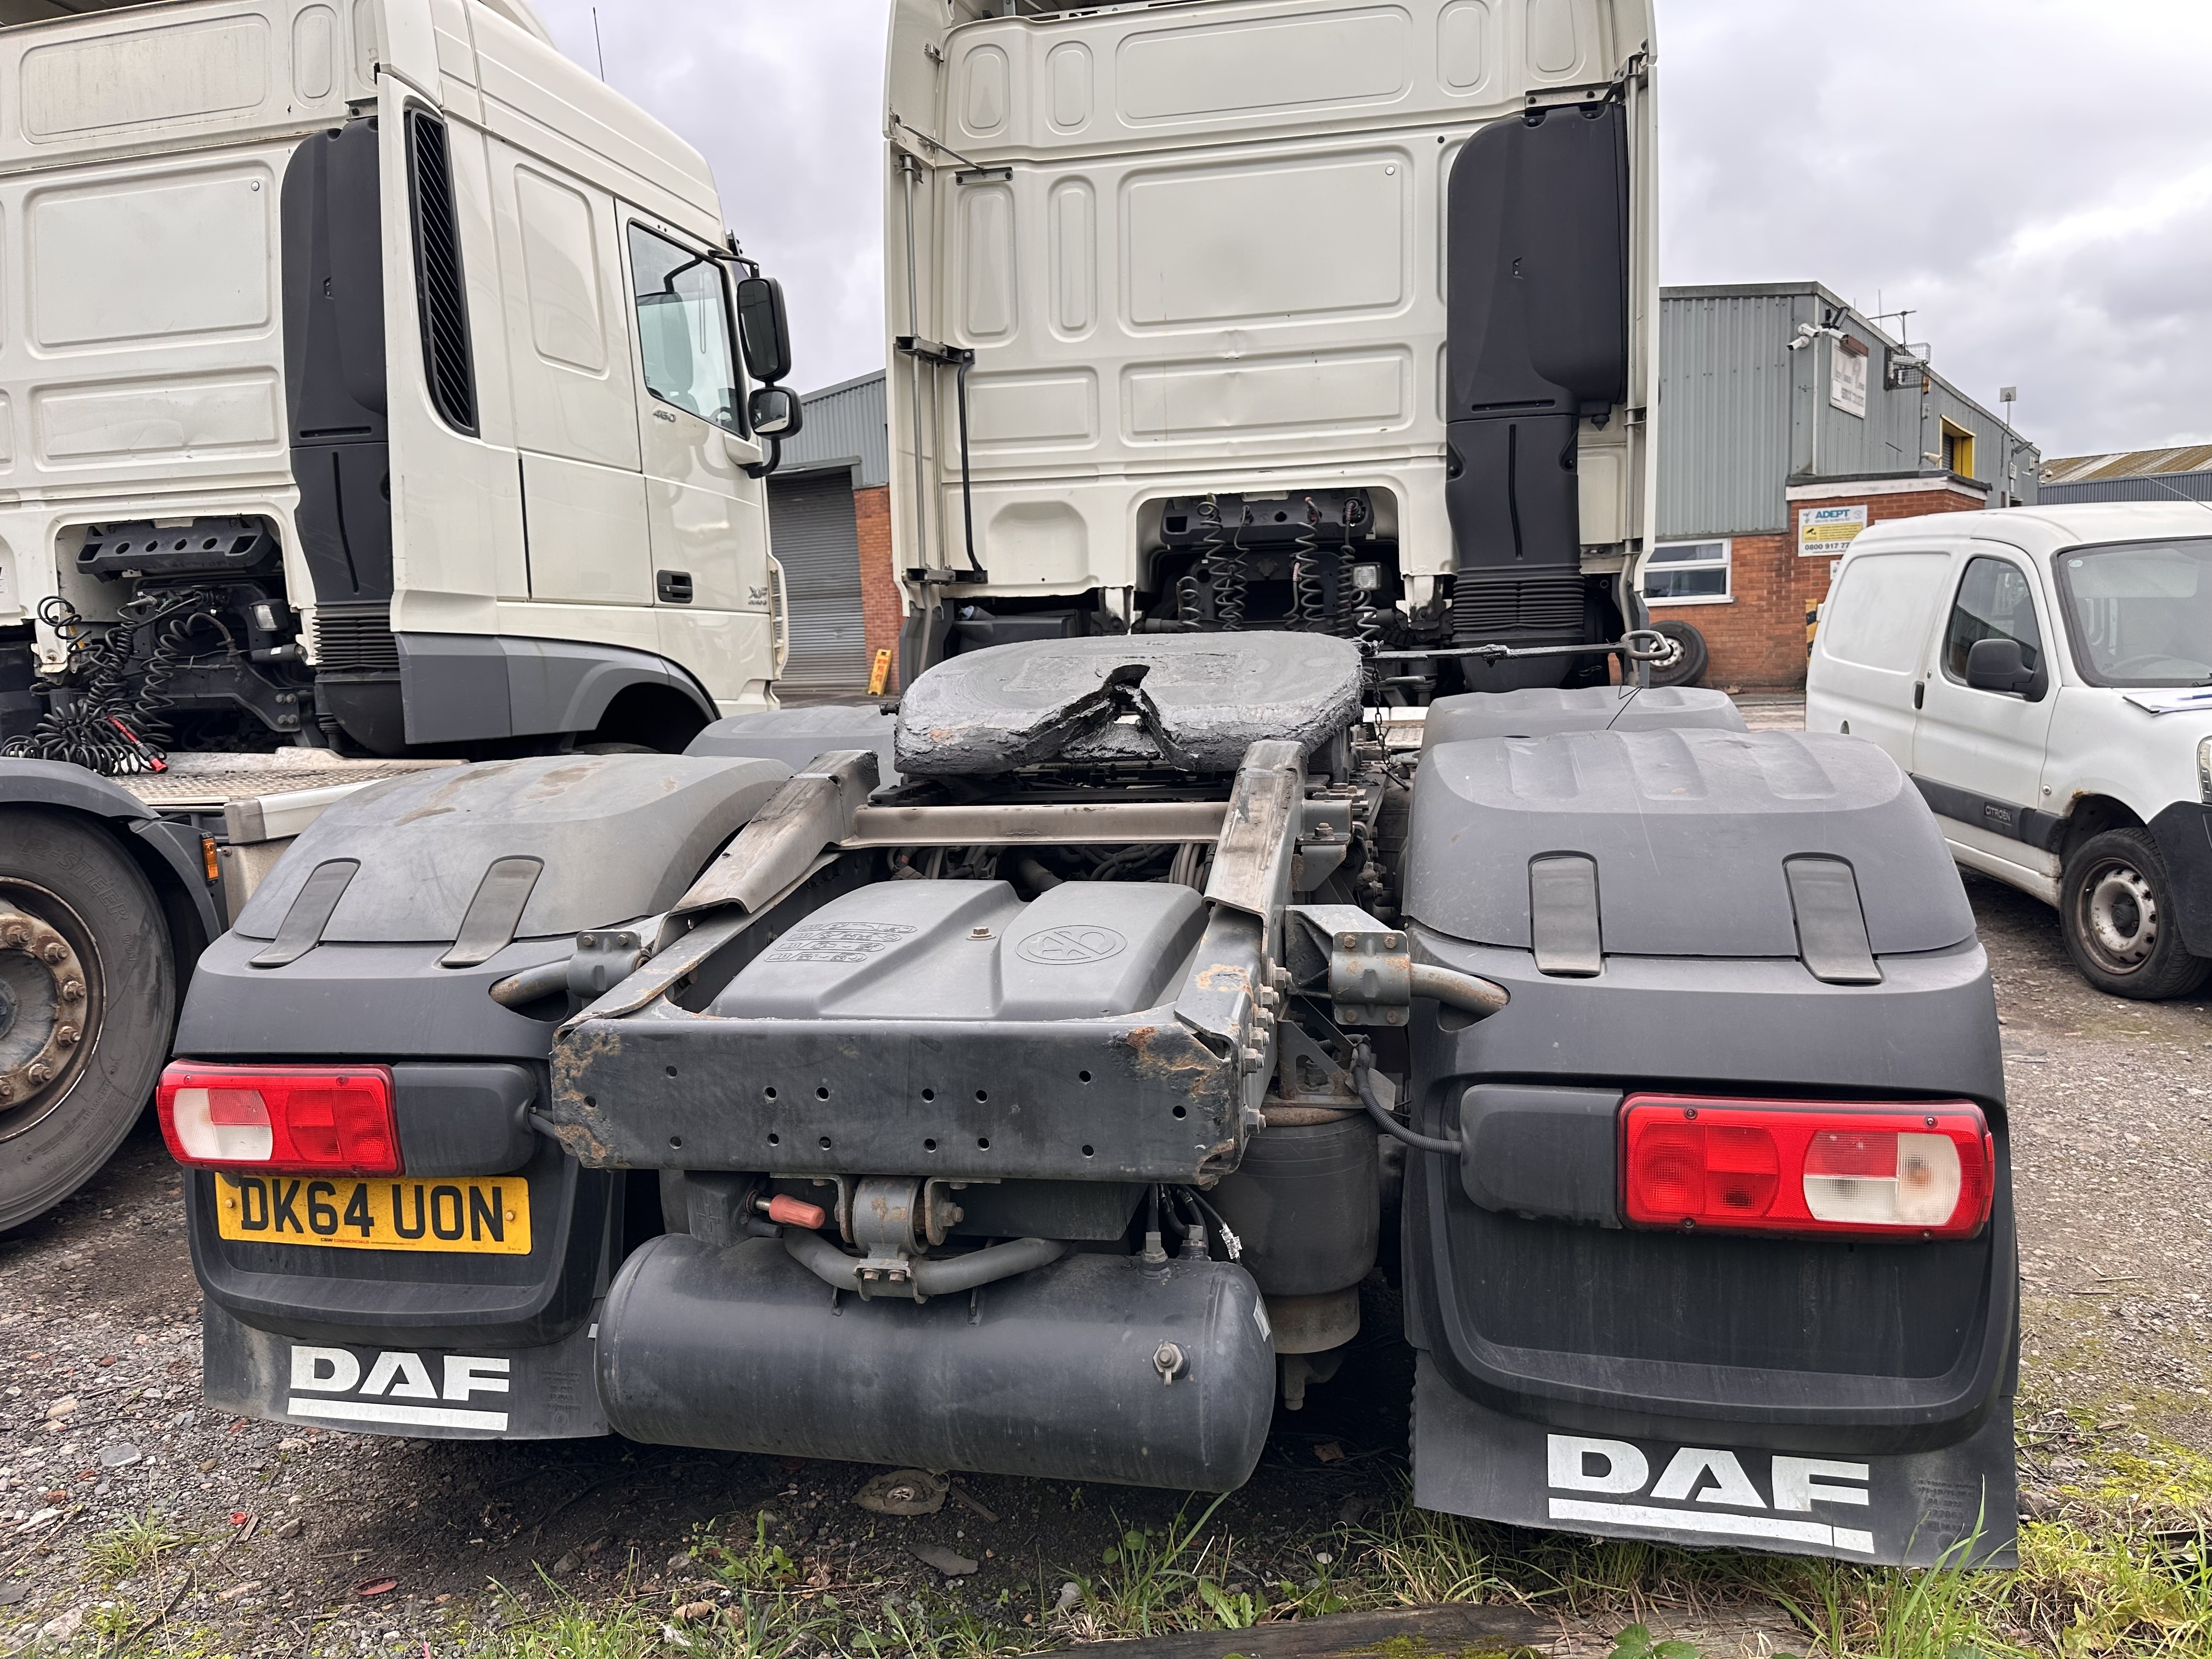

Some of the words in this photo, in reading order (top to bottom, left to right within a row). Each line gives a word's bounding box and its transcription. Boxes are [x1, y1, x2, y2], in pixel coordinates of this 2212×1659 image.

[653, 410, 676, 422] 460
[1815, 509, 1850, 519] ADEPT
[748, 586, 768, 599] XF
[19, 838, 129, 924] R-STEER
[122, 934, 137, 962] 001
[240, 1178, 374, 1237] DK64
[392, 1184, 504, 1242] UON
[290, 1345, 510, 1401] DAF
[1548, 1434, 1869, 1512] DAF
